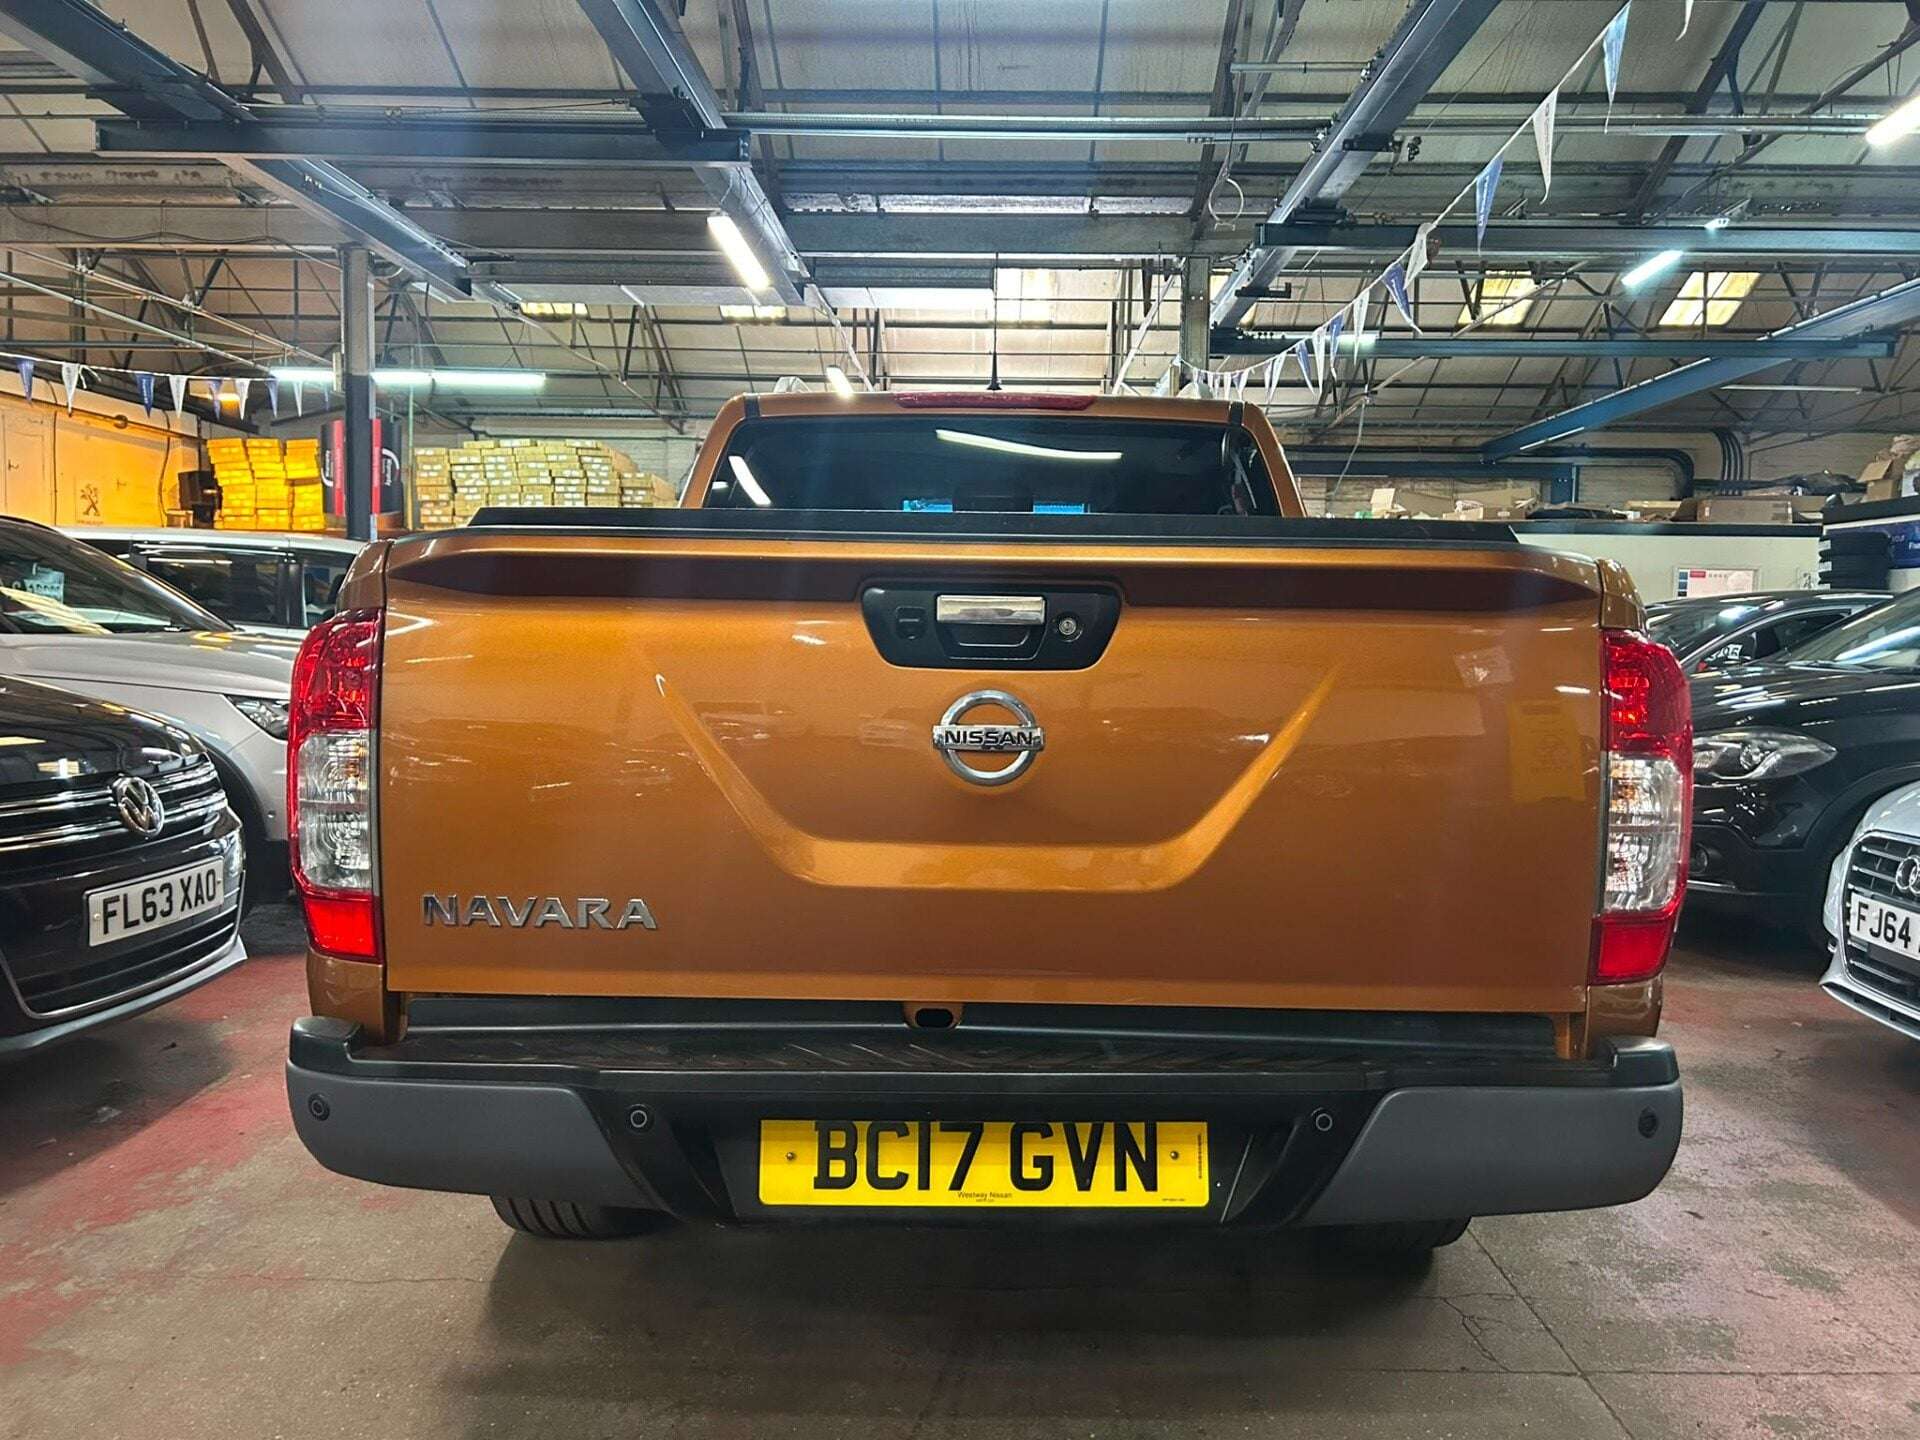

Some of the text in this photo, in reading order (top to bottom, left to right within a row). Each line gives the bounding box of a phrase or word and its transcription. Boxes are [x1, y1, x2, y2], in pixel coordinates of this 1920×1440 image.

[944, 730, 1033, 745] NISSAN
[102, 868, 216, 935] FL63 XAO
[423, 893, 657, 930] NAVARA
[1856, 902, 1911, 950] FJ64
[813, 1120, 984, 1190] BC17
[1009, 1121, 1158, 1192] GVN
[957, 1191, 988, 1199] Westway
